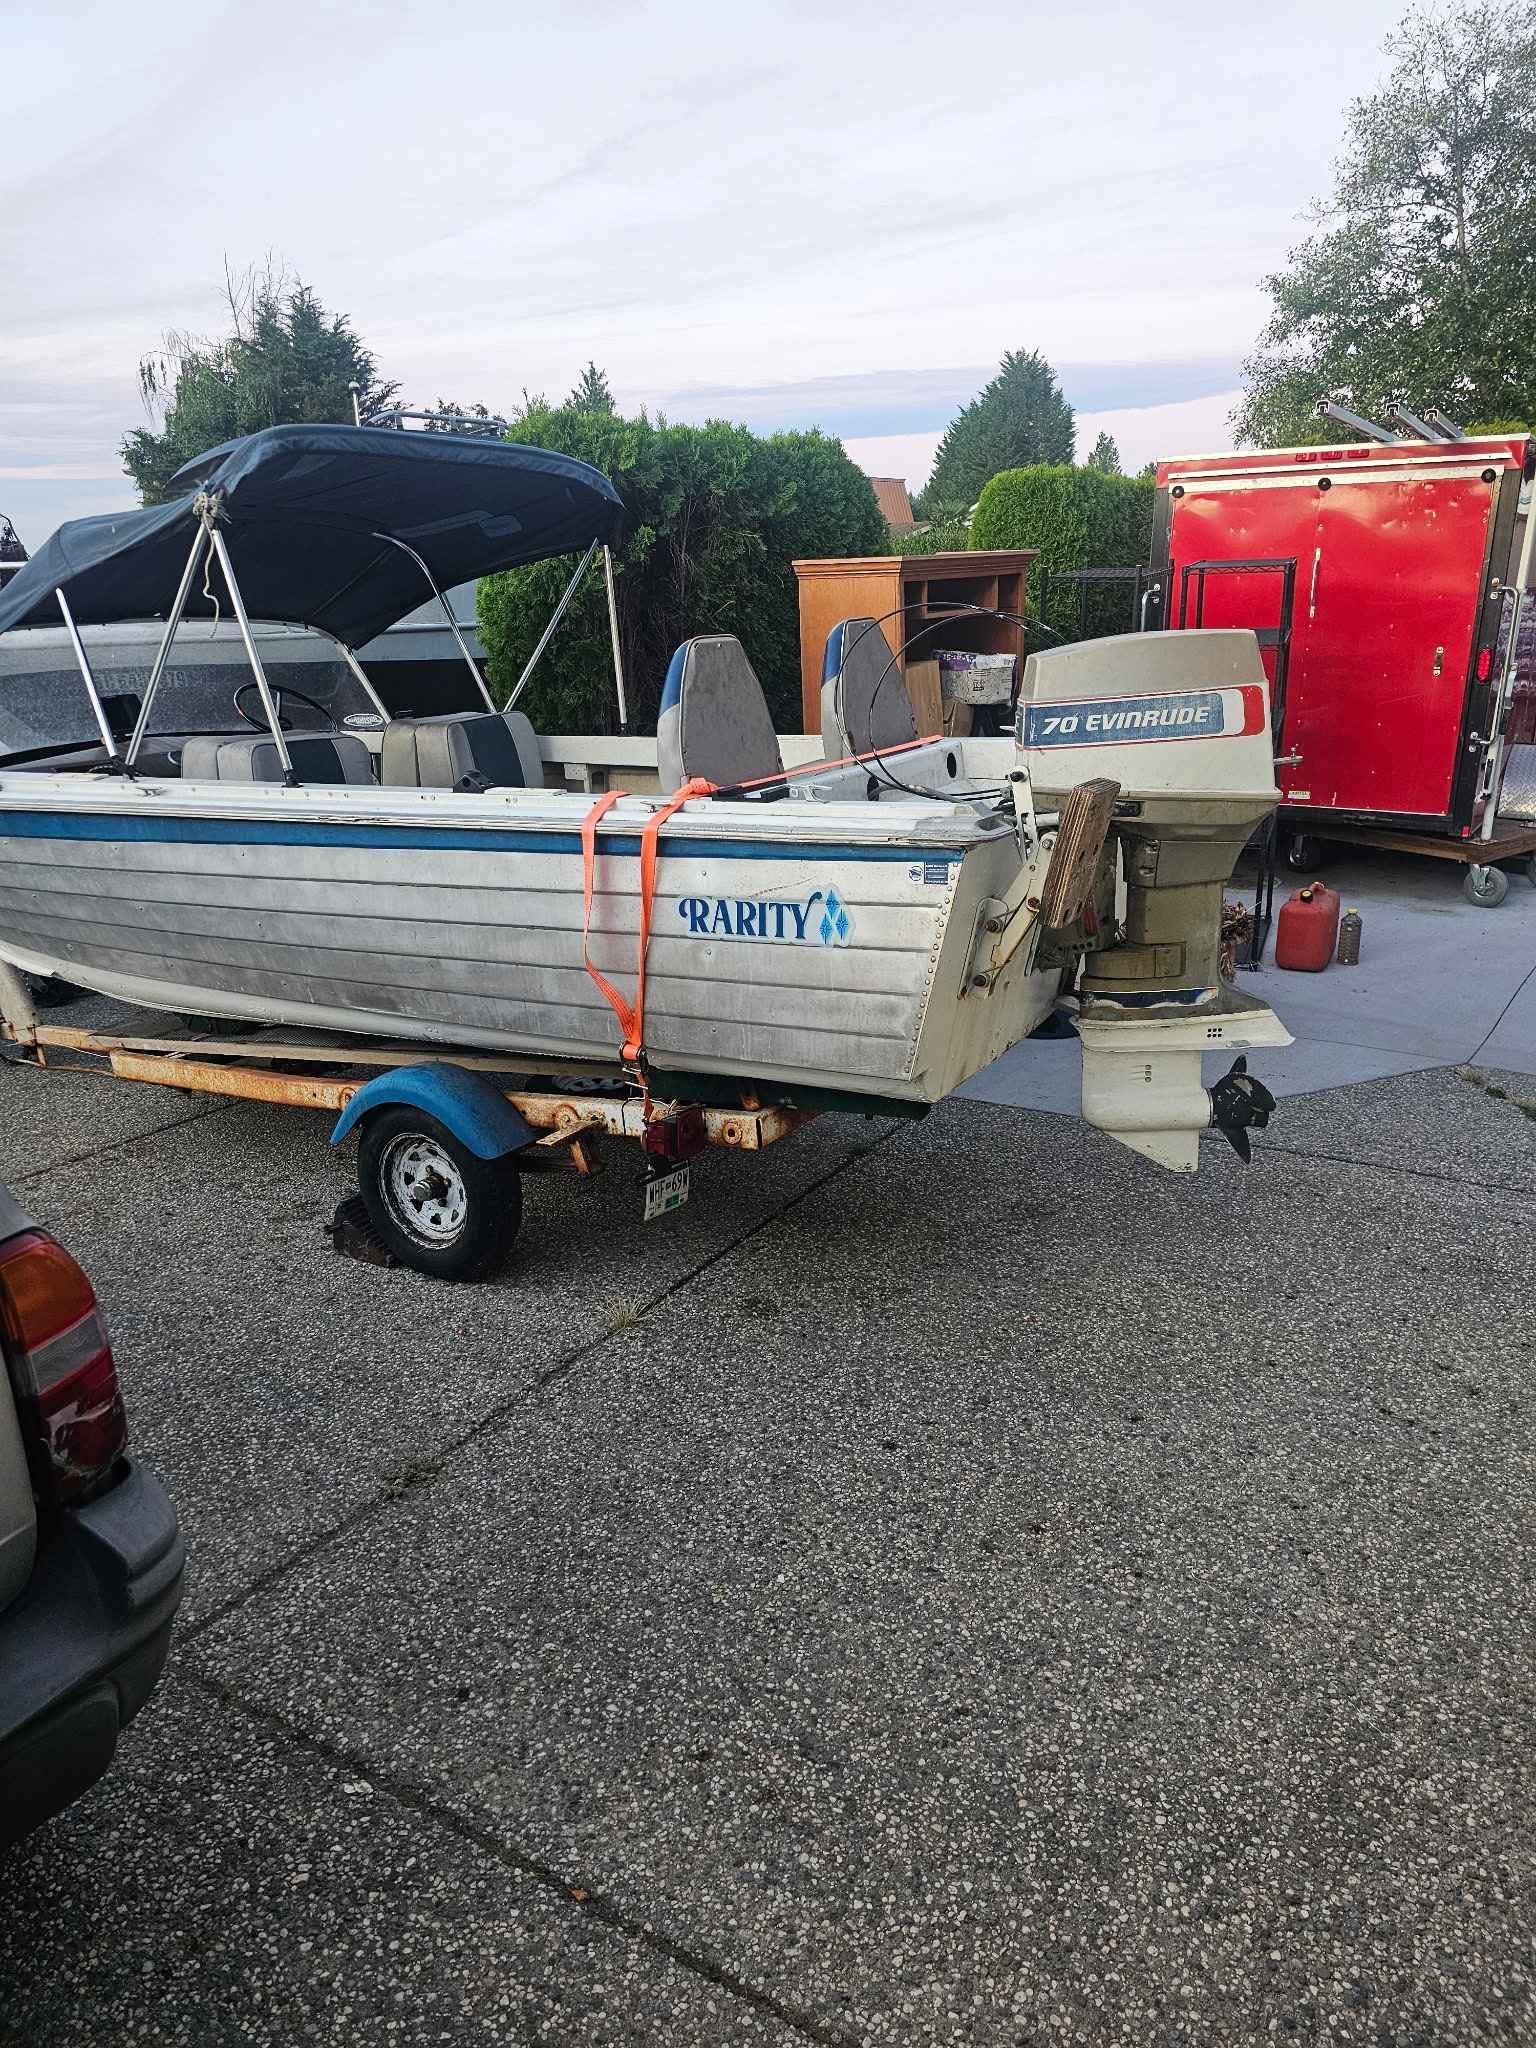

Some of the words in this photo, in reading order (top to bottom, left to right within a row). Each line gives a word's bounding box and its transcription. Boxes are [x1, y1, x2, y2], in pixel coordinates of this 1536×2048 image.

[1041, 716, 1078, 735] 70
[1085, 706, 1211, 731] EVINRUDE
[678, 891, 823, 939] RARITY
